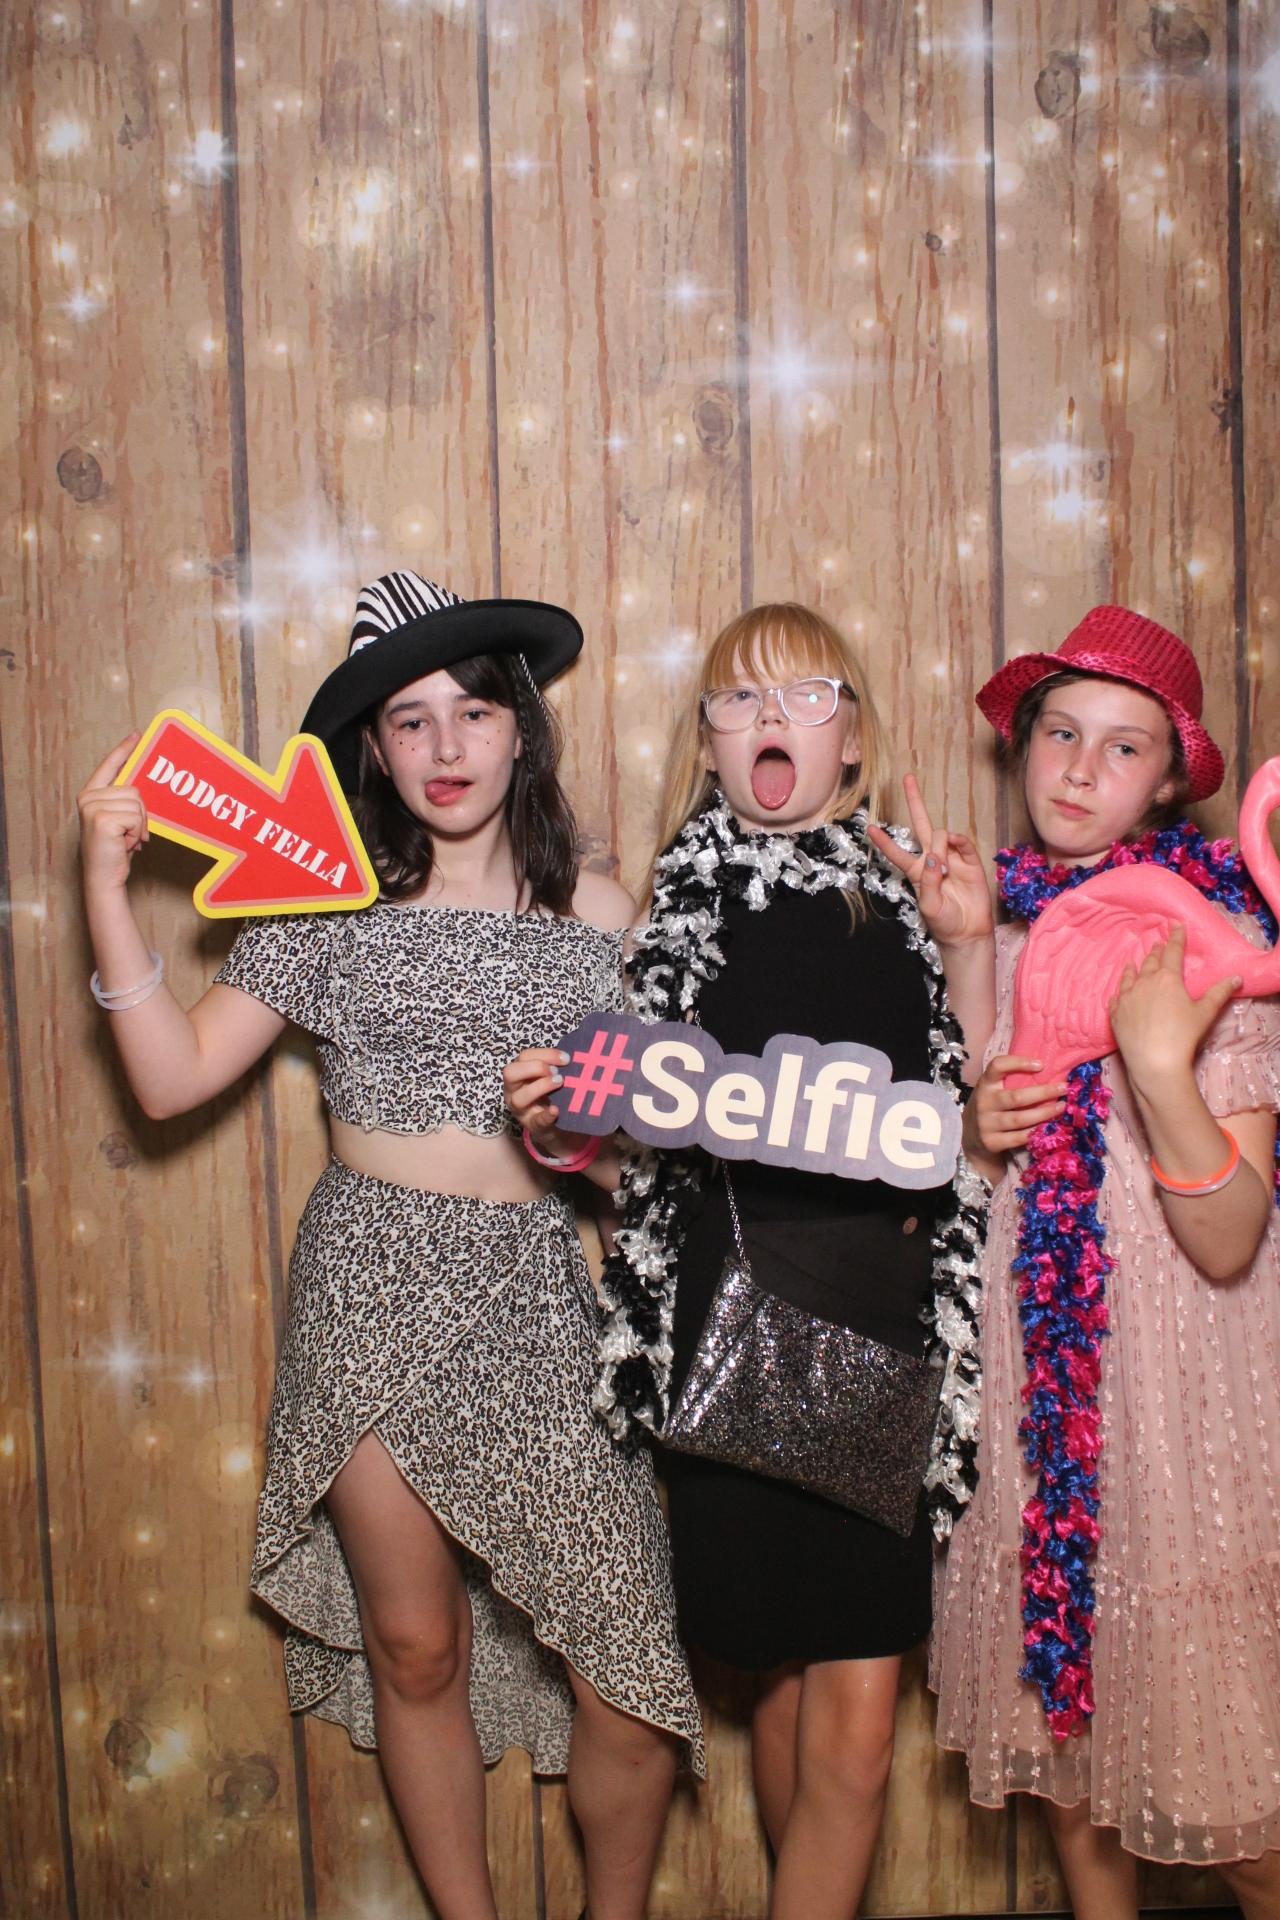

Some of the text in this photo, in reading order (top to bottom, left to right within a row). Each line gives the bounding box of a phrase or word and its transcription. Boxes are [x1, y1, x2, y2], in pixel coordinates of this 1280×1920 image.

[146, 755, 348, 889] DODGY FELLA
[564, 1030, 942, 1169] #Selfie
